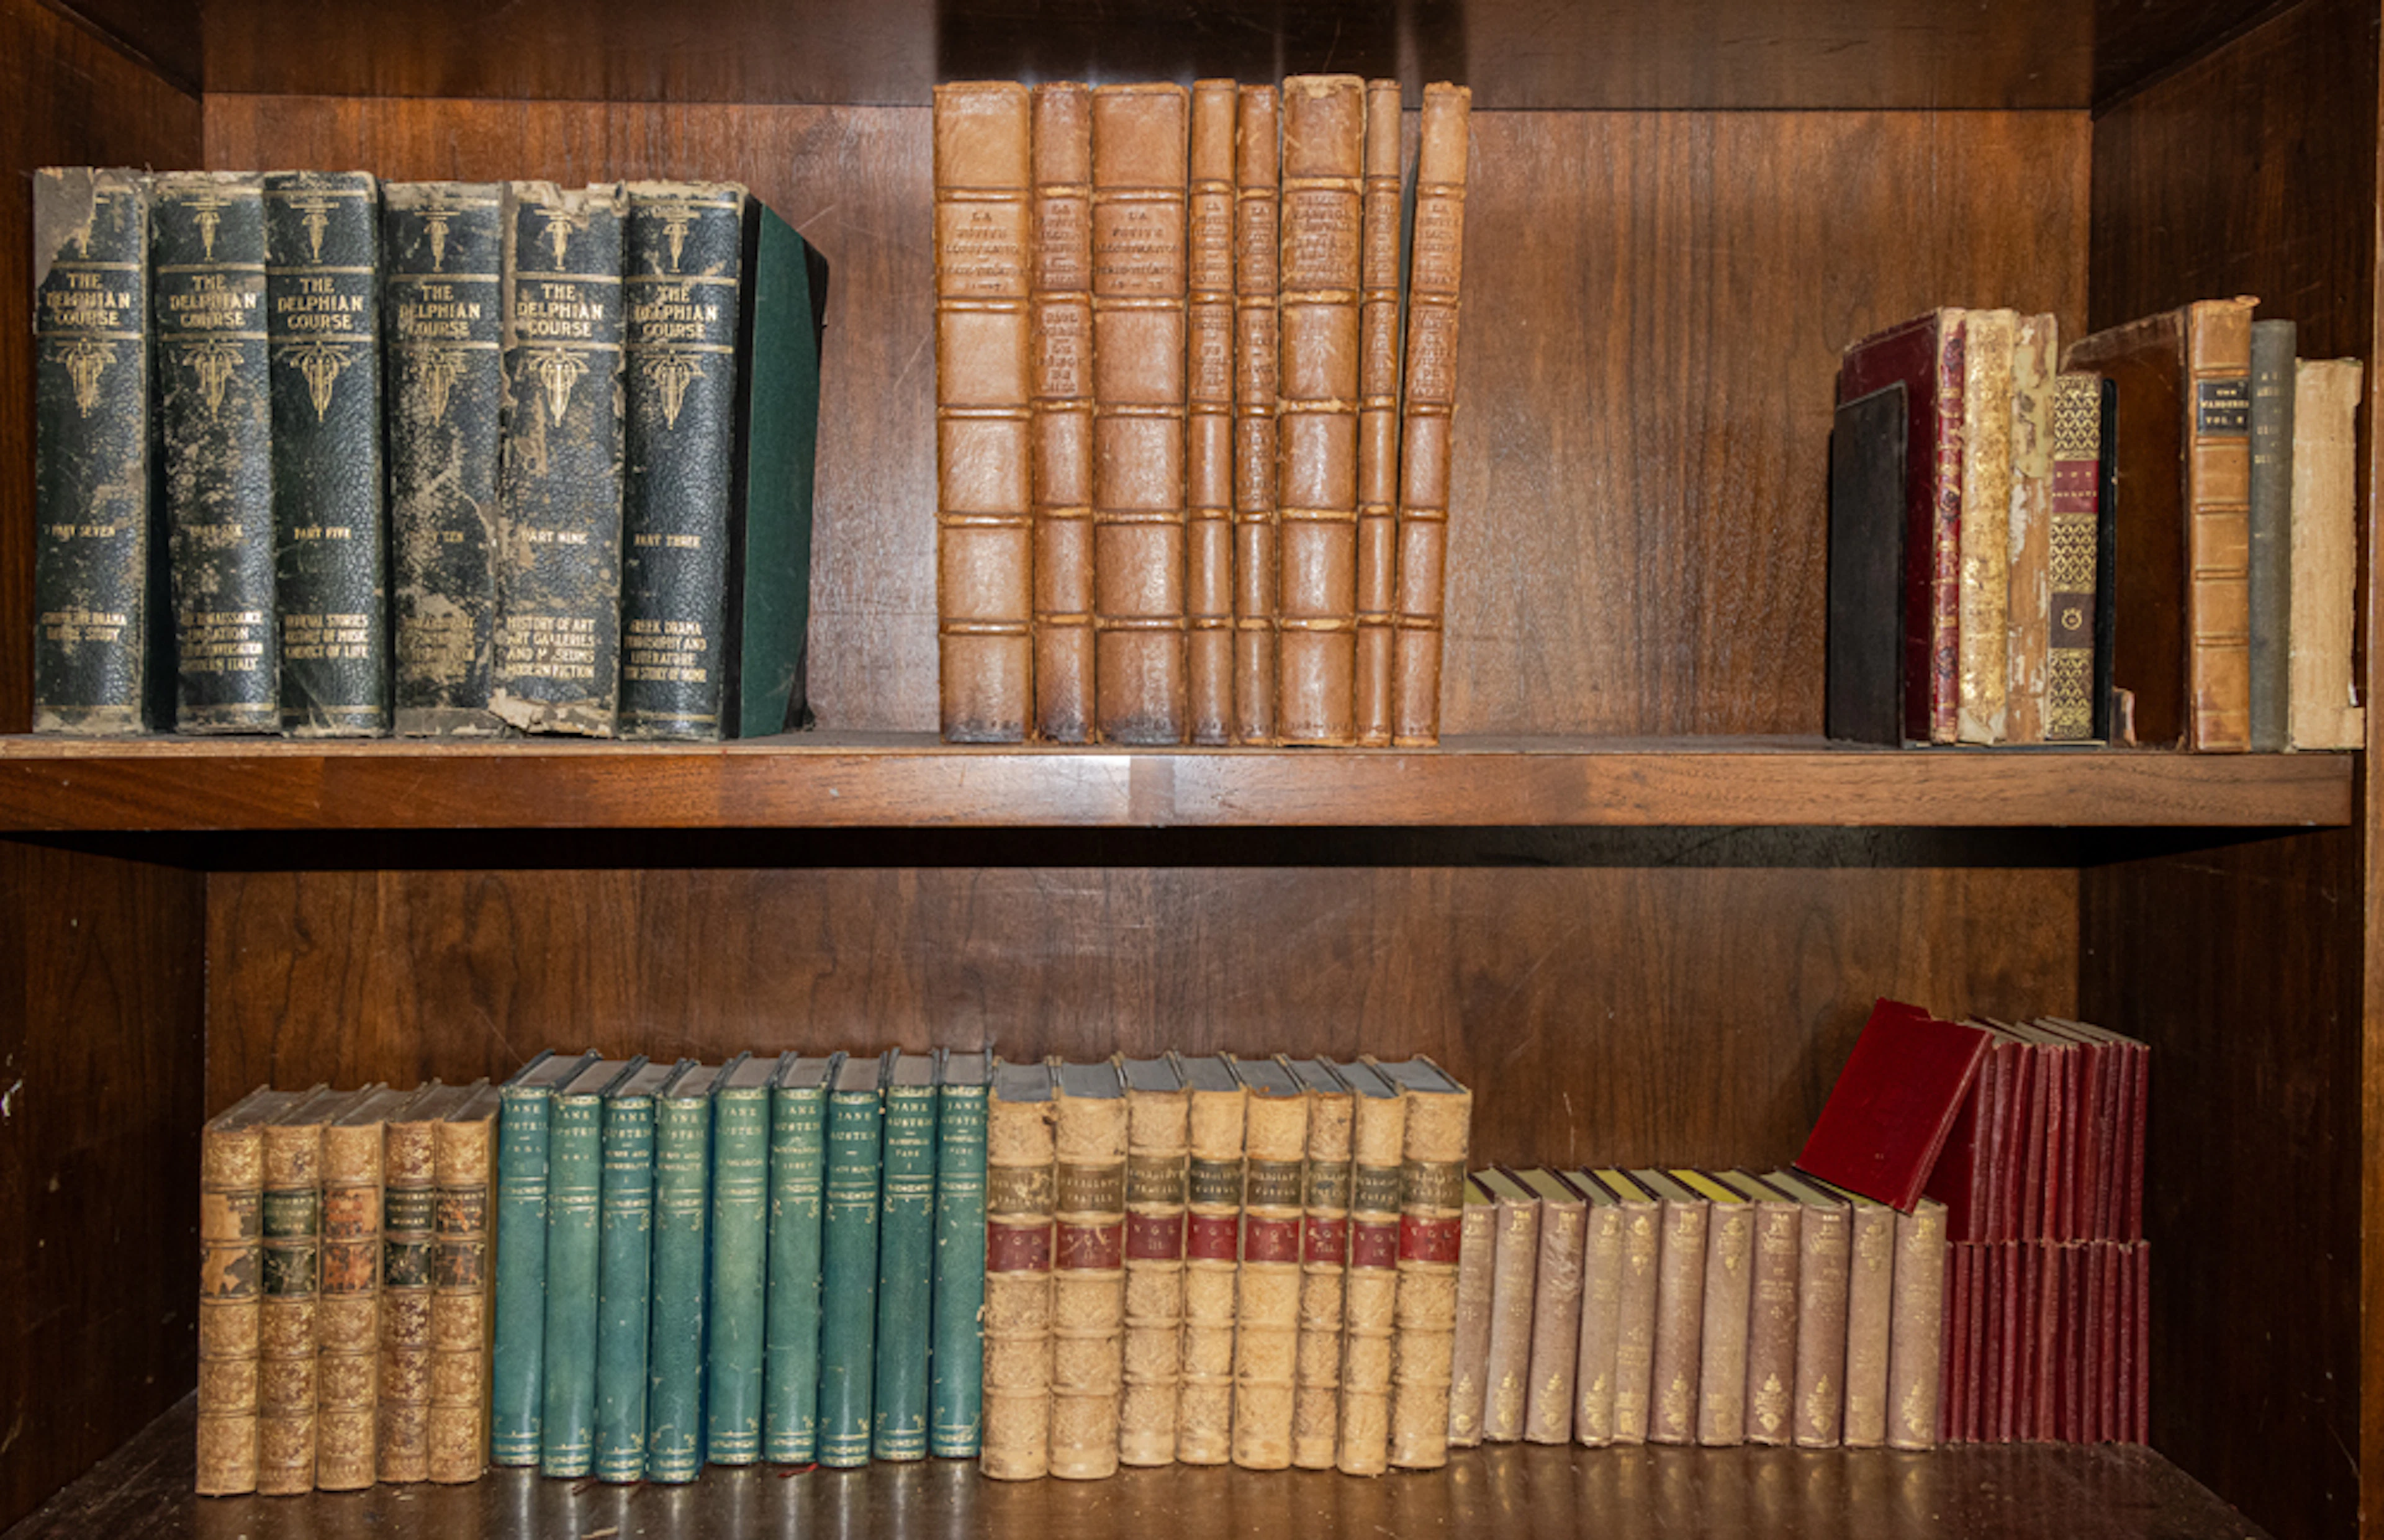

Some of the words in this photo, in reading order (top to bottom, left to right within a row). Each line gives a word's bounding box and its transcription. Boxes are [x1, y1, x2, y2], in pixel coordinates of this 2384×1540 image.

[66, 273, 102, 288] THE
[192, 274, 225, 291] THE
[299, 278, 335, 294] THE
[421, 285, 454, 302] THE
[540, 283, 576, 300] THE
[656, 285, 690, 303] THE
[277, 295, 364, 312] DELPHIAN
[517, 302, 604, 320] DELPHIAN
[287, 314, 353, 331] COURSE
[528, 320, 592, 338] COURSE
[642, 323, 707, 338] COURSE
[556, 618, 572, 633] OF
[572, 618, 595, 633] ART
[506, 646, 535, 662] AND
[536, 647, 595, 662] MSEUMS
